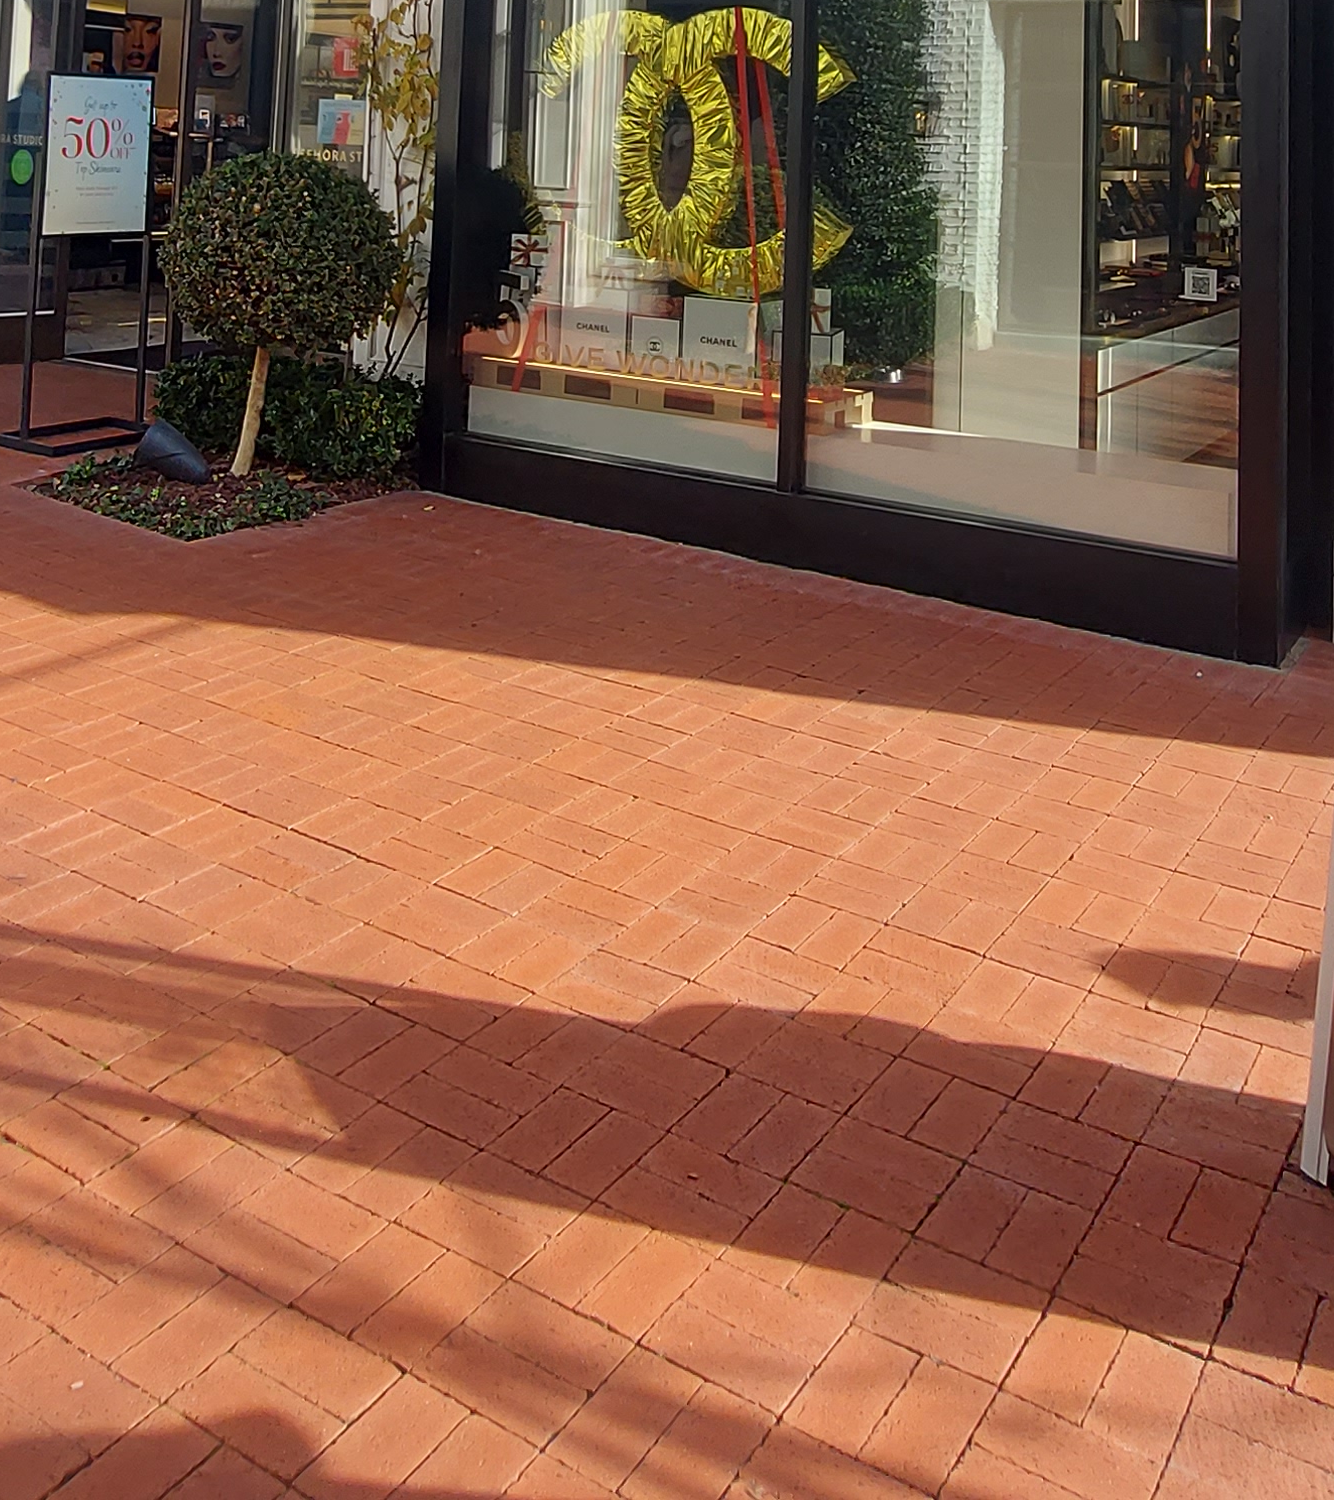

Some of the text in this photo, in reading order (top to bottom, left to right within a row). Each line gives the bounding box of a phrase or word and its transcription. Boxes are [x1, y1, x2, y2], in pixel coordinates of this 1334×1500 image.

[60, 115, 135, 160] 50%
[575, 322, 610, 334] CHANEL
[699, 335, 738, 348] CHANEL
